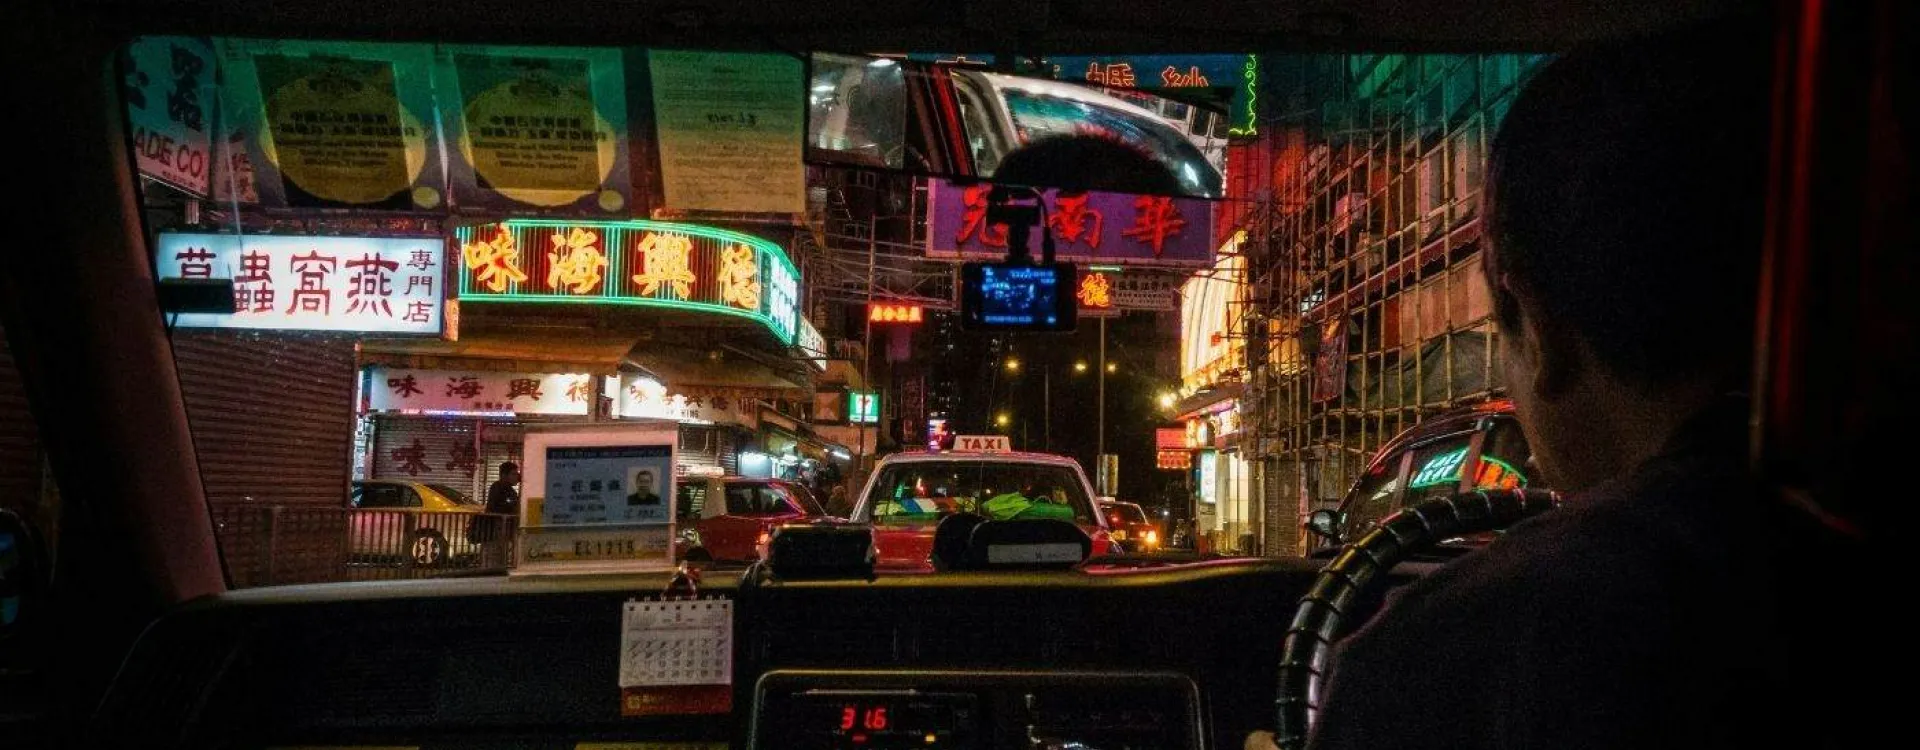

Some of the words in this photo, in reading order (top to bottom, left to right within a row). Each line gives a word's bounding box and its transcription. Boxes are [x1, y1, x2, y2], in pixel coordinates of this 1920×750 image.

[403, 249, 436, 323] 專門店
[962, 438, 1002, 450] TAXI
